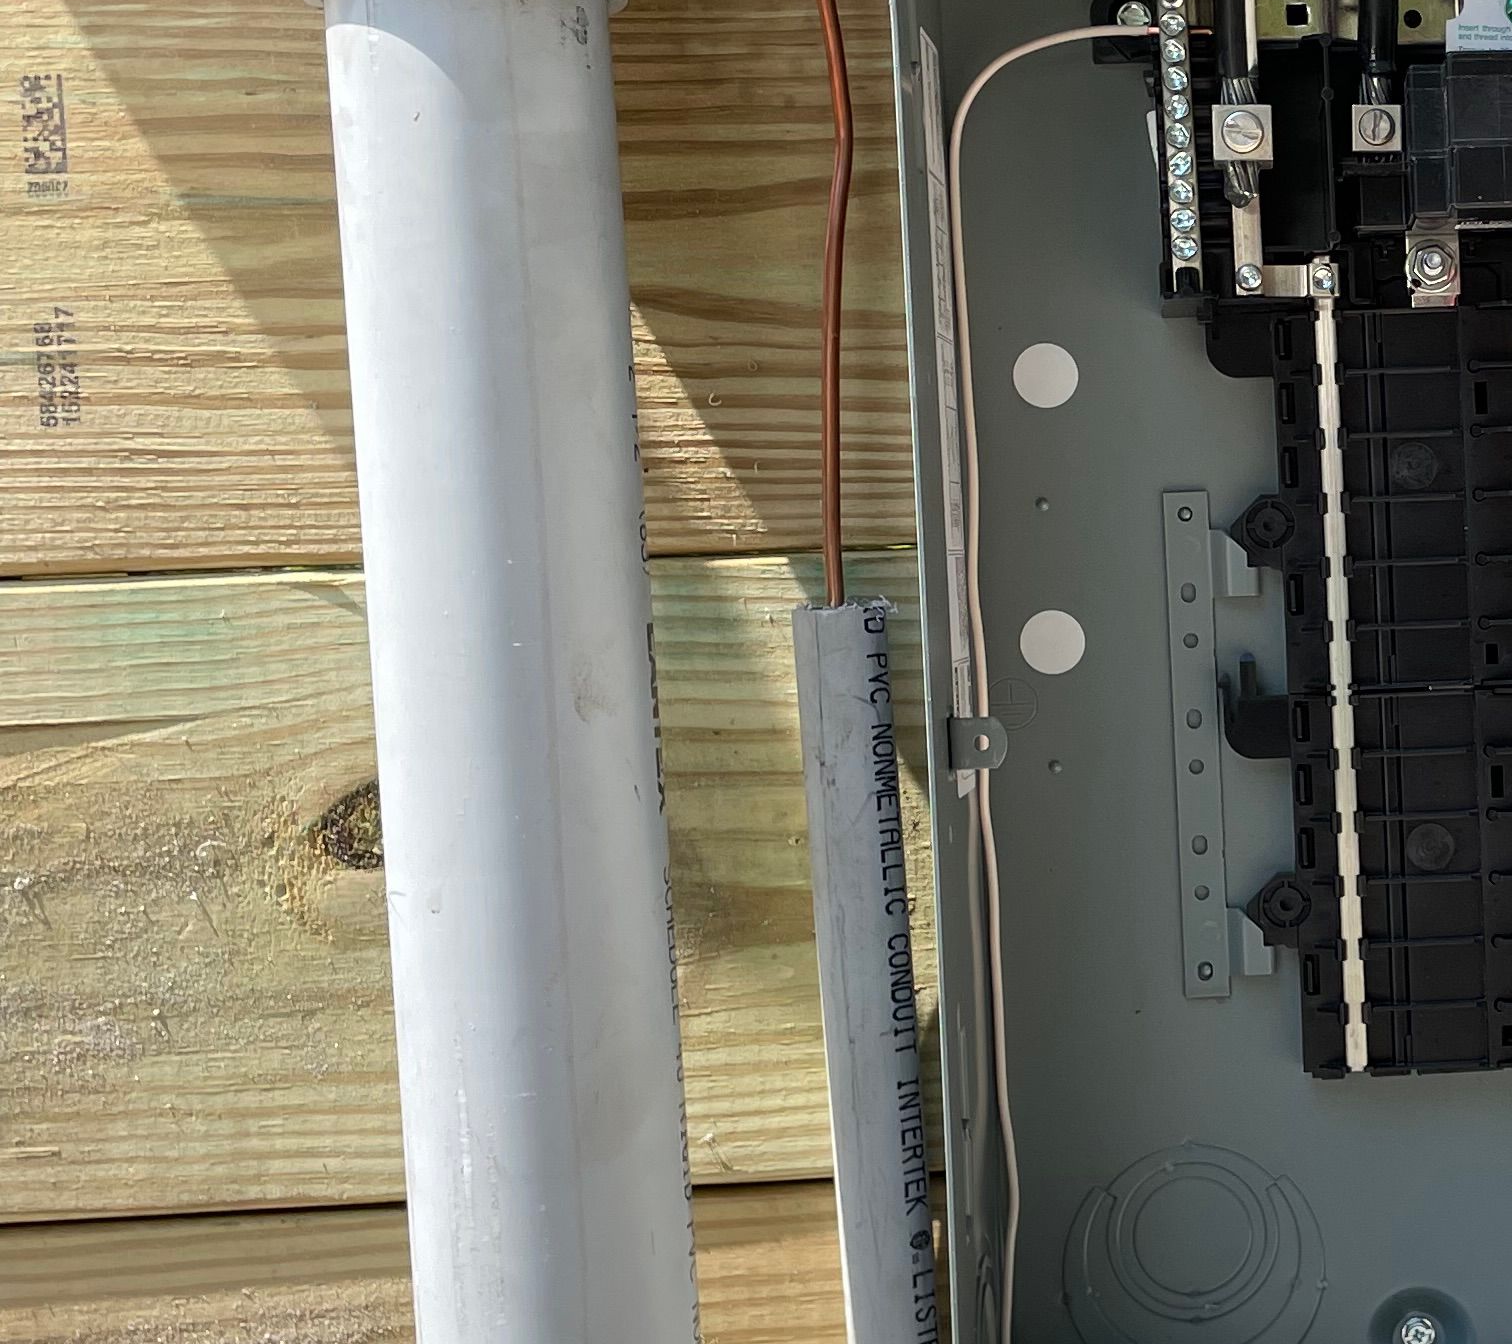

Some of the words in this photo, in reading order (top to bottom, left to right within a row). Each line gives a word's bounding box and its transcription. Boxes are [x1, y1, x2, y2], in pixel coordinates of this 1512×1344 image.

[866, 652, 890, 704] PVC
[871, 723, 907, 915] NONMETALLIC
[887, 933, 918, 1054] CONDUIT
[897, 1077, 928, 1216] INTERTEK
